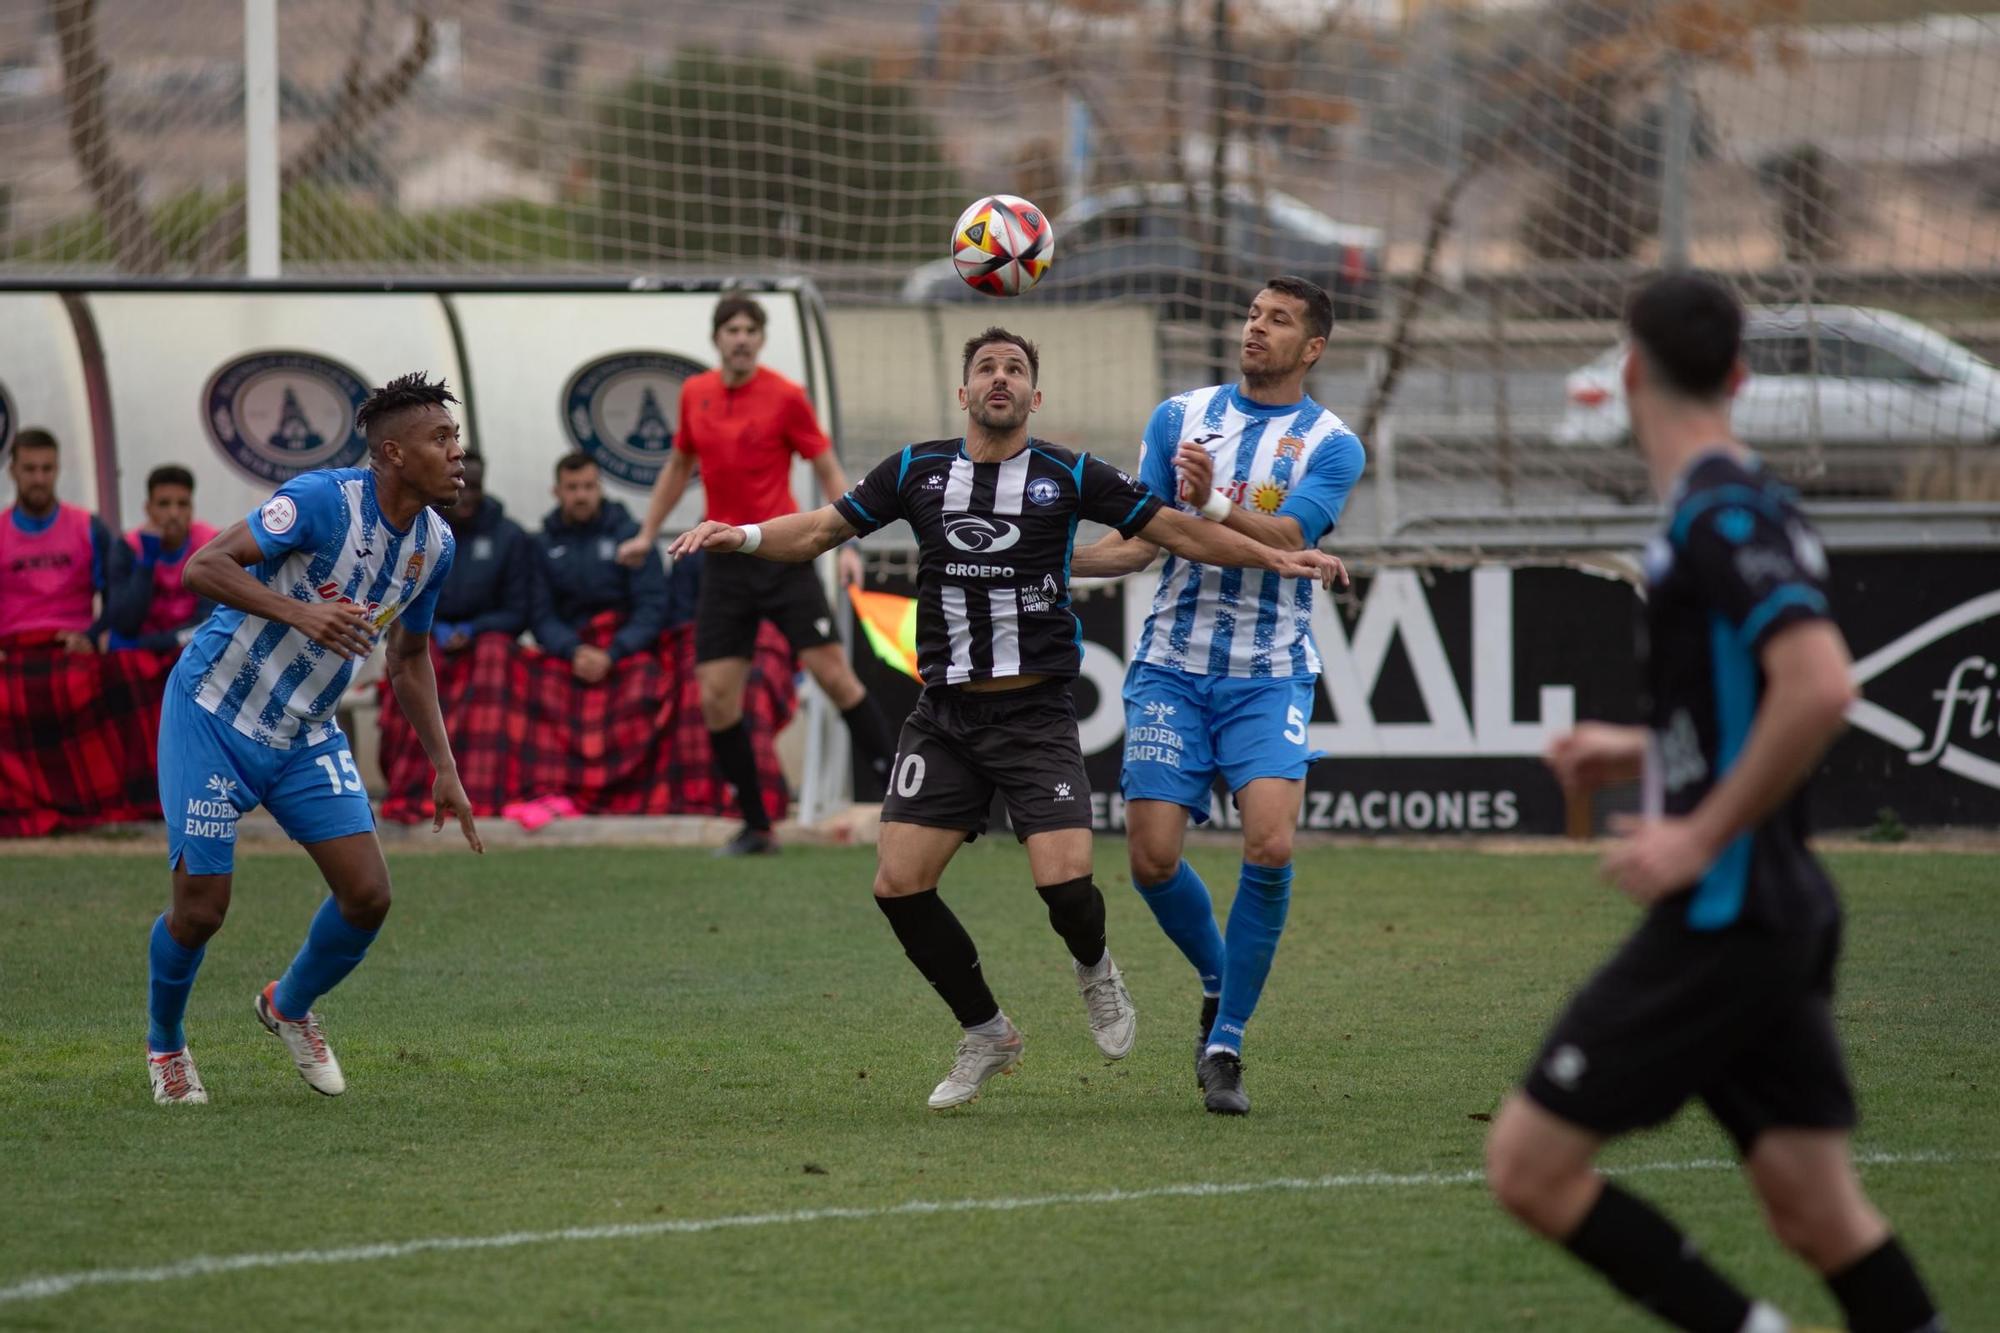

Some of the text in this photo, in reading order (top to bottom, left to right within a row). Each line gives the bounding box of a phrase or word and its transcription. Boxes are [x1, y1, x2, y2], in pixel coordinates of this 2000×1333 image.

[945, 562, 1016, 578] GROEPO
[1283, 704, 1306, 745] 5
[1906, 655, 2000, 767] fi
[315, 750, 362, 795] 15
